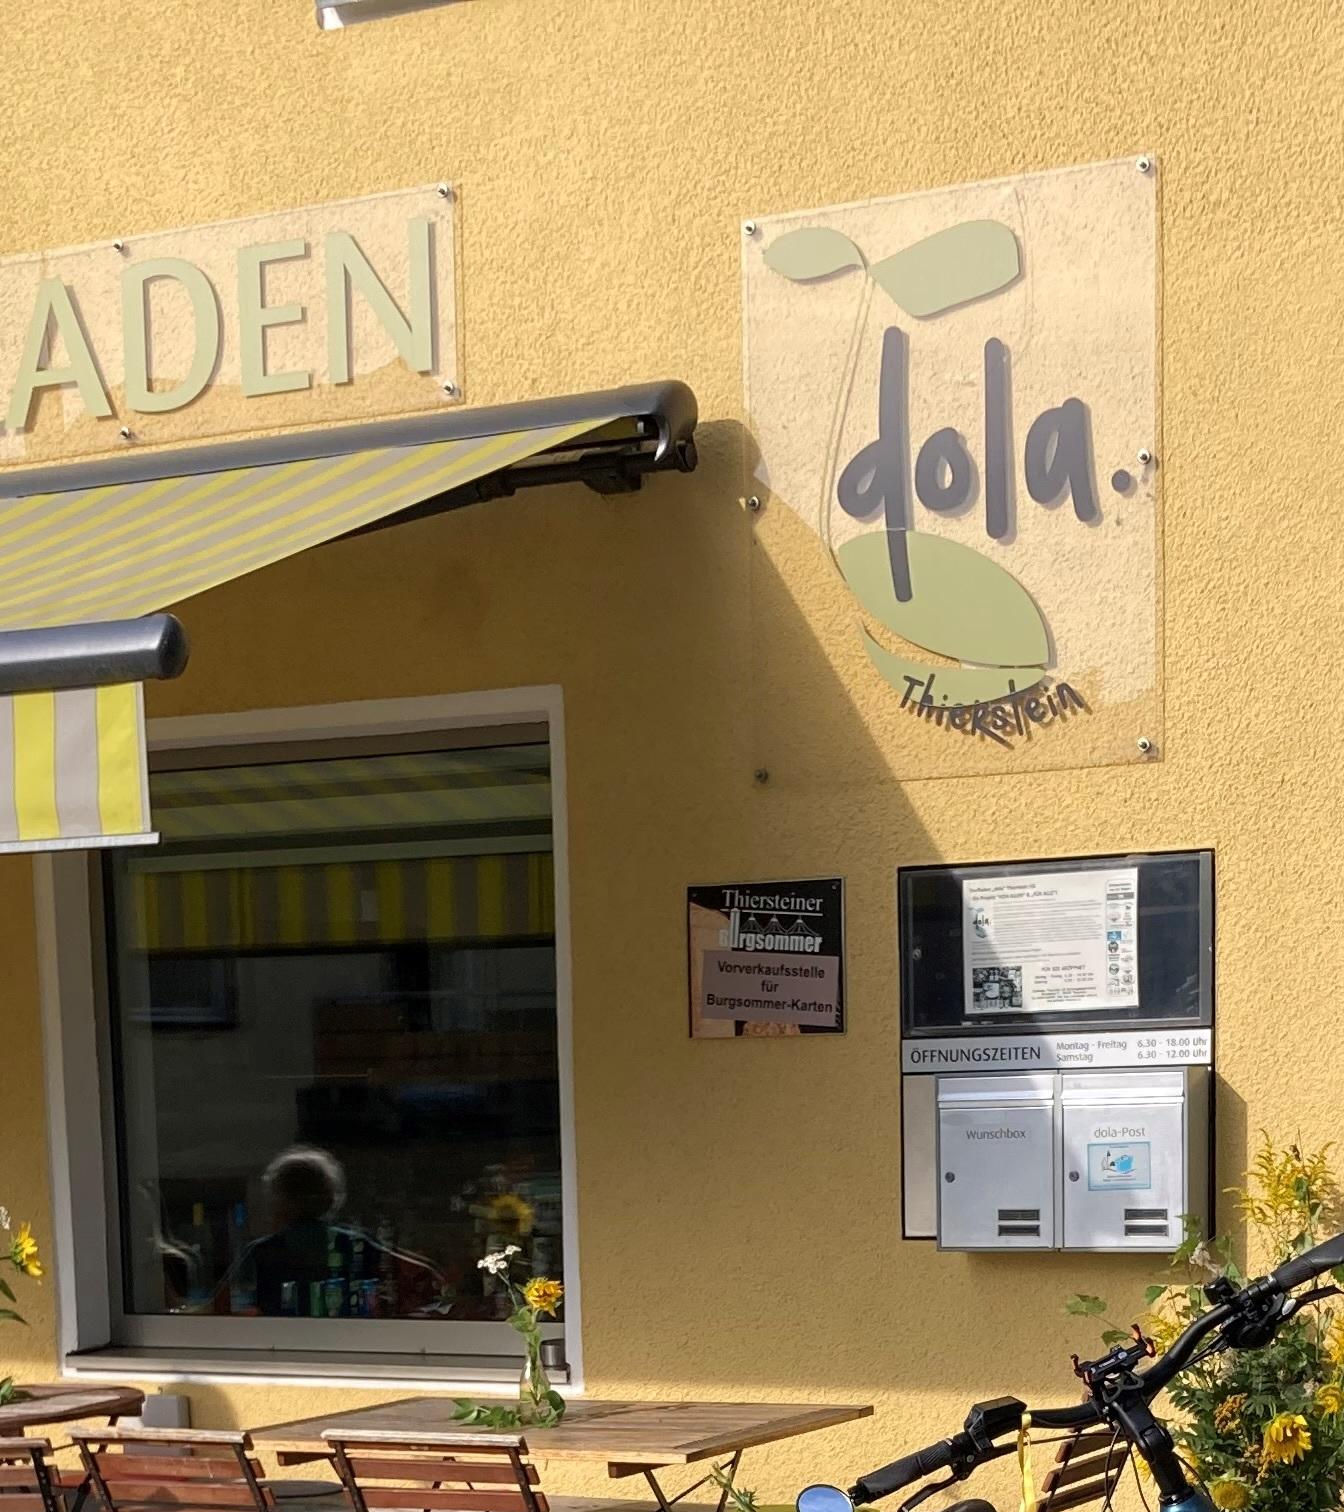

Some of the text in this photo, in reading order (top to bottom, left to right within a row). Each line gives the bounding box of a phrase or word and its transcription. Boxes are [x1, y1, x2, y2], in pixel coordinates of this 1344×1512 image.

[899, 673, 1086, 750] Thierstein
[722, 889, 823, 911] Thiersteiner
[717, 960, 825, 979] Vorverkaufsstelle
[761, 980, 779, 993] für
[706, 994, 833, 1013] Burgsommer-Karten
[1056, 1041, 1089, 1052] Montag
[1097, 1039, 1127, 1051] Freitag
[1137, 1038, 1156, 1048] 6.30
[1165, 1037, 1190, 1047] 18.00
[1192, 1036, 1208, 1046] Uhr
[910, 1046, 1041, 1065] ÖFFNUNGSZEITEN
[1056, 1051, 1094, 1063] Samstag
[1137, 1049, 1156, 1060] 6.30
[1166, 1048, 1190, 1059] 12.00
[1192, 1048, 1208, 1058] Uhr
[966, 1127, 1026, 1140] Wunschbox
[1094, 1126, 1146, 1138] dola-Post
